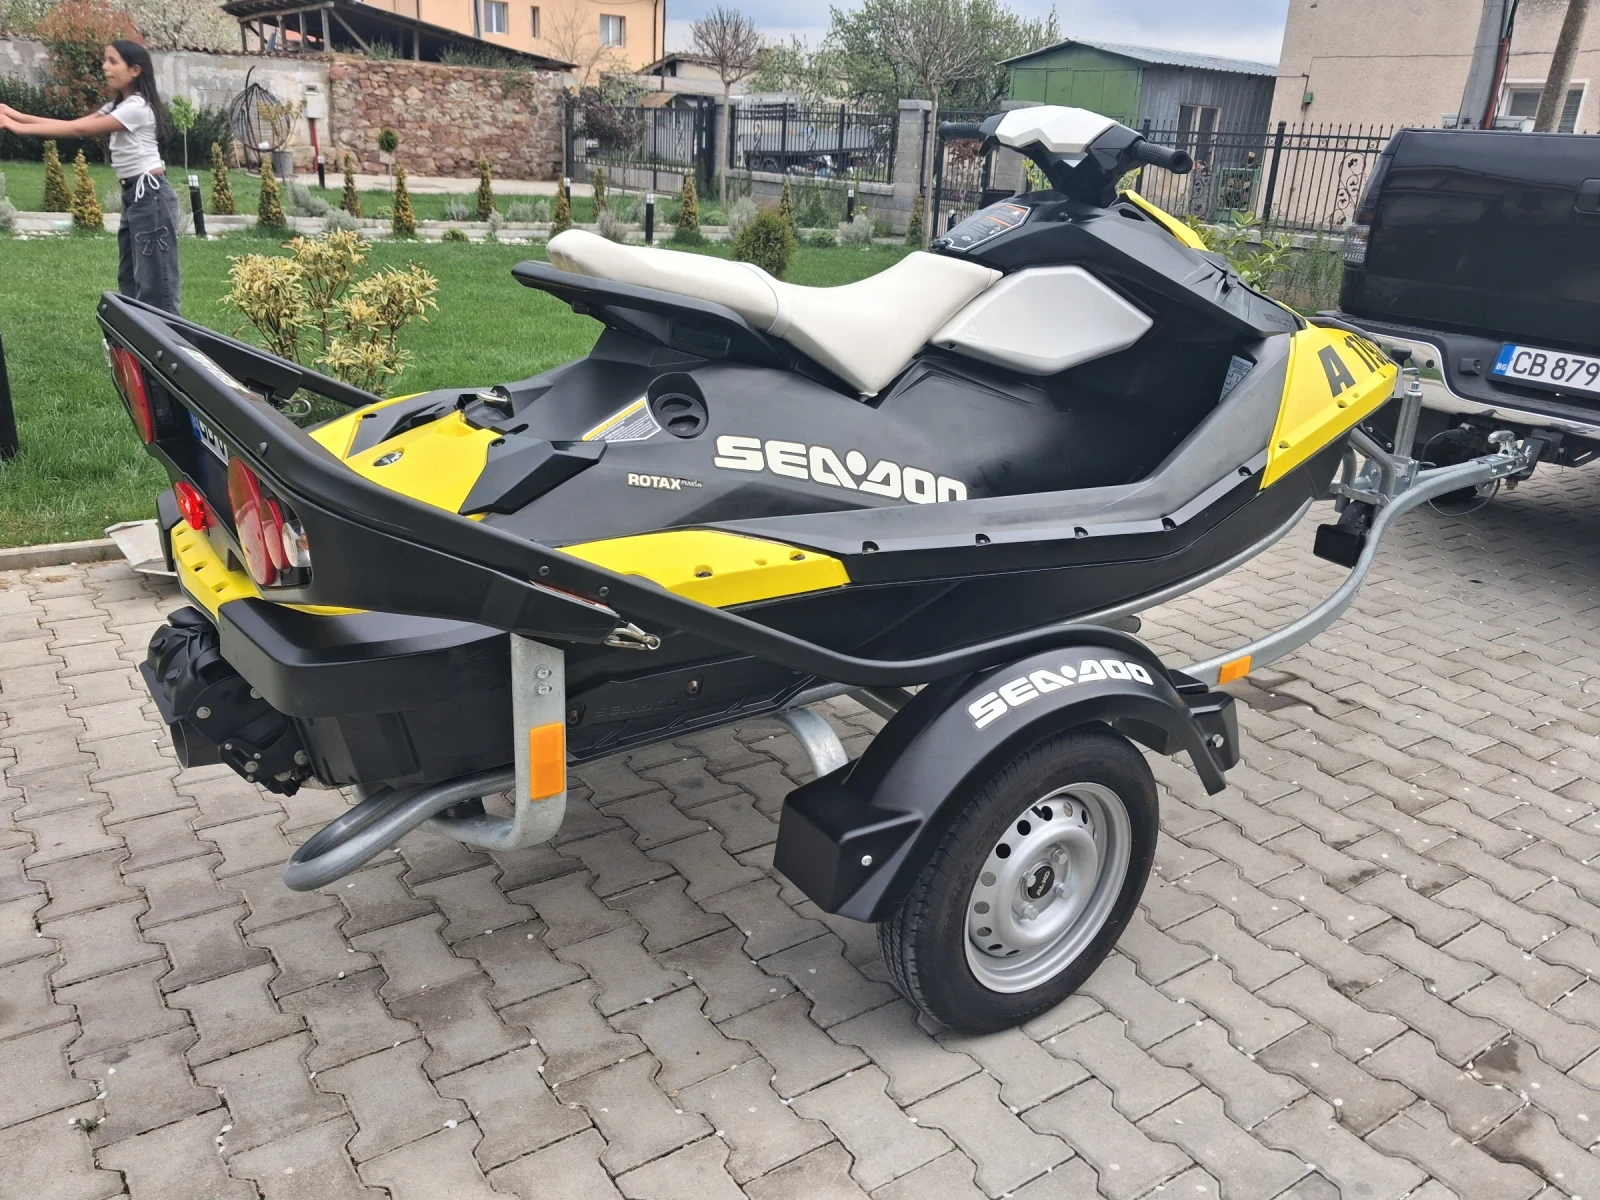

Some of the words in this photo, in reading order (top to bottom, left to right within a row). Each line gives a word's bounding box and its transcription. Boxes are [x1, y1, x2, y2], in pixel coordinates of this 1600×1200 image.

[1317, 344, 1356, 398] A
[1495, 362, 1508, 371] BG
[1512, 351, 1548, 377] CB
[1550, 357, 1600, 386] 879
[628, 472, 682, 491] ROTAX
